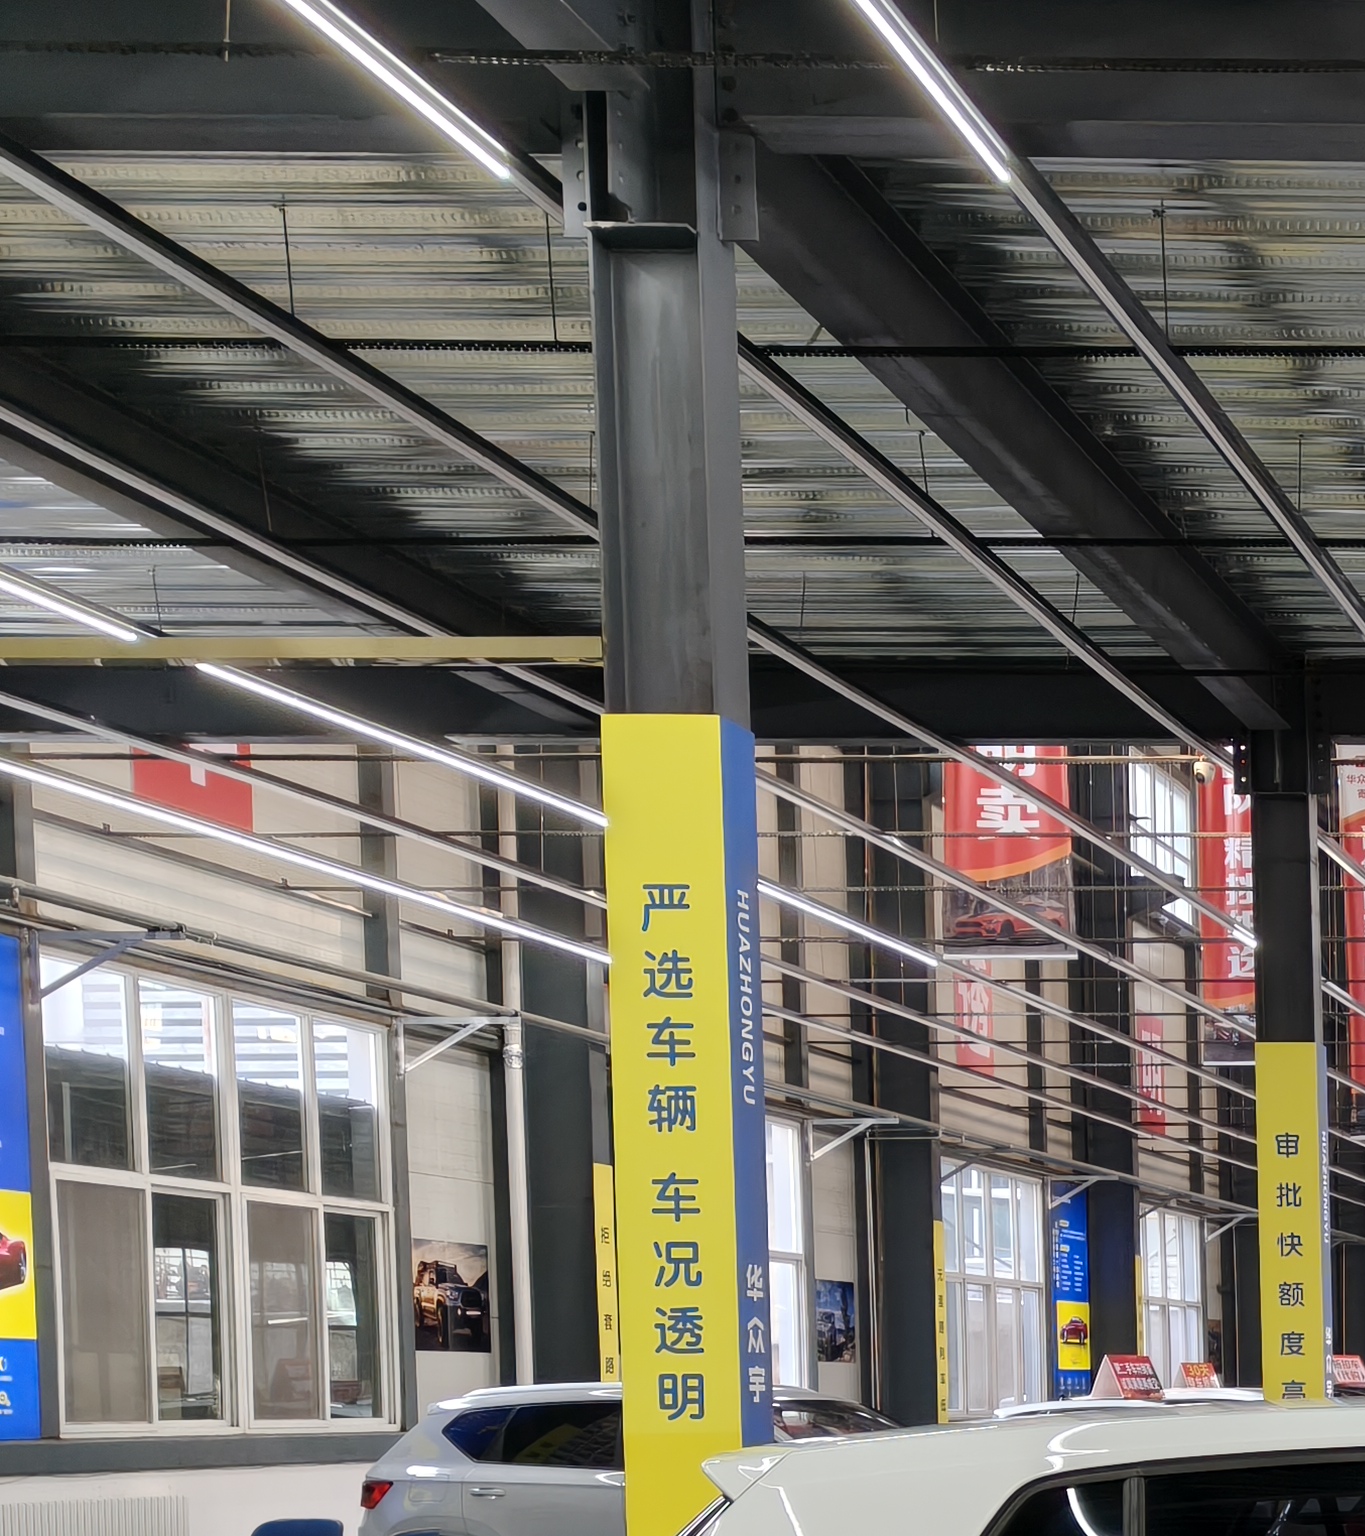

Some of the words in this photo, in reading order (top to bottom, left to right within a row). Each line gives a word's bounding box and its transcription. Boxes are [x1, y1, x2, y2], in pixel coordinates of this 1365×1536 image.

[641, 883, 698, 1133] 严选车辆
[735, 889, 757, 1107] HUAZHONGYU
[650, 1171, 706, 1421] 车况透明
[745, 1263, 766, 1403] 华众宇
[1275, 1132, 1306, 1400] 审批快额度高
